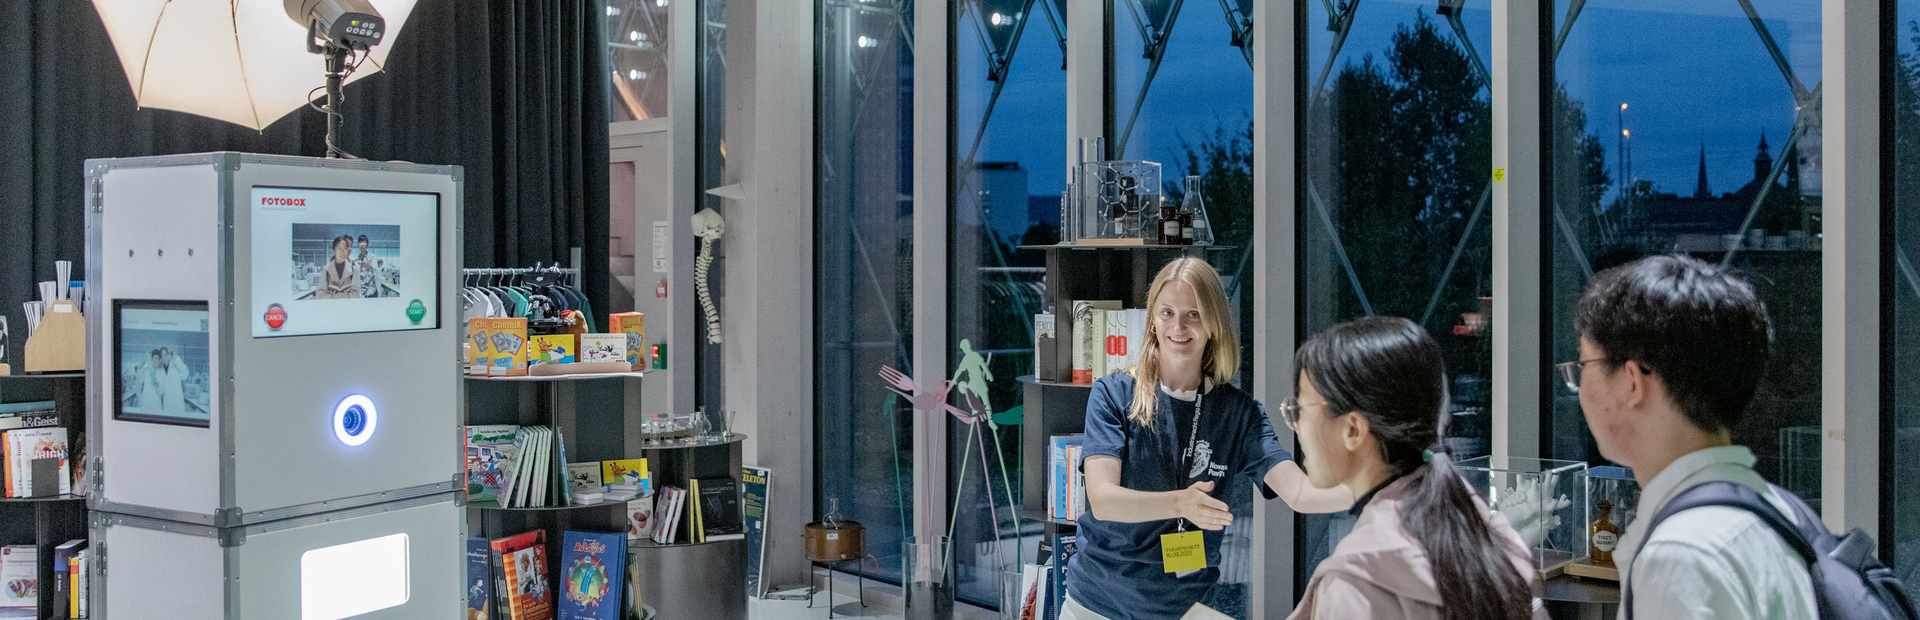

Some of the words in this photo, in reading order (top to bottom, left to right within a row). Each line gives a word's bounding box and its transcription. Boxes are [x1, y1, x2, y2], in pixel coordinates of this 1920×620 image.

[262, 197, 306, 206] FOTOBOX
[492, 320, 522, 329] ChemiX
[1187, 421, 1198, 457] Industrienacht
[1166, 544, 1200, 552] Industrienacht
[1166, 550, 1192, 558] 16.09.2022
